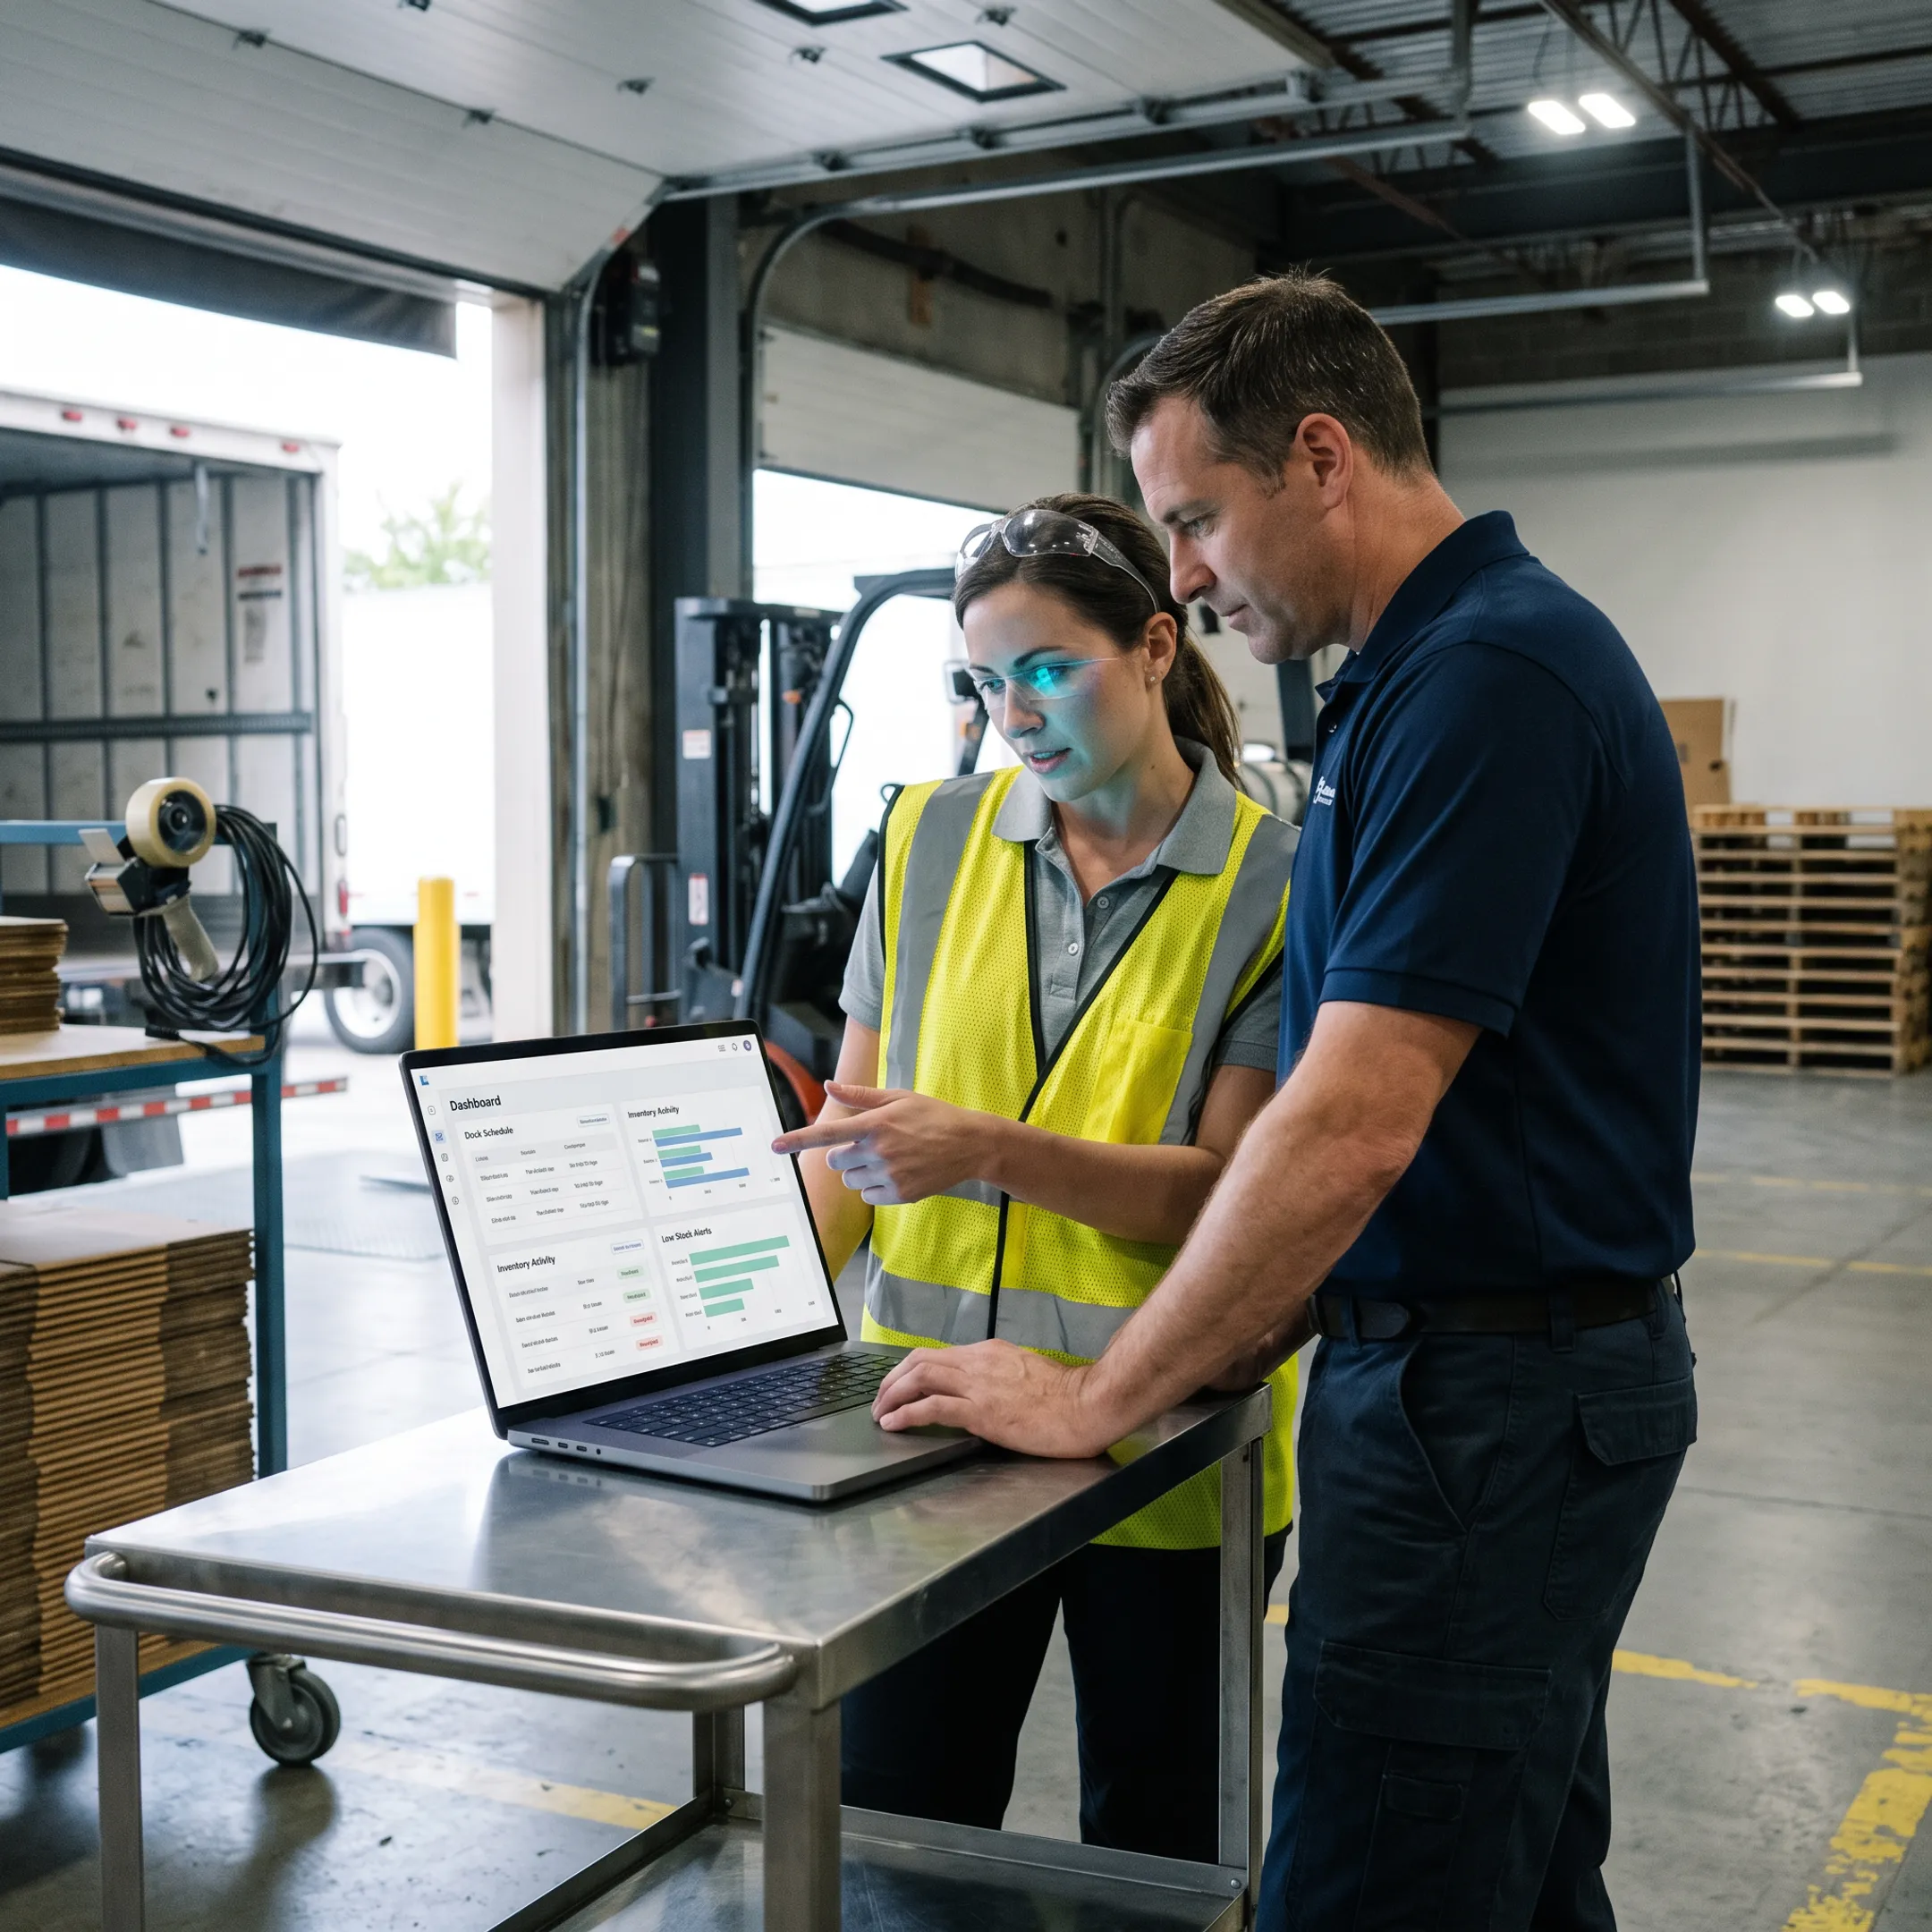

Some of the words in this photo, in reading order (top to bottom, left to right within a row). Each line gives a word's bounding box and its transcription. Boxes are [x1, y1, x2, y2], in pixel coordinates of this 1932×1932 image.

[449, 1095, 502, 1111] Dashboard
[464, 1130, 482, 1140] Dock
[483, 1126, 513, 1137] Schedule
[661, 1235, 674, 1243] Low
[496, 1261, 530, 1273] Inventory
